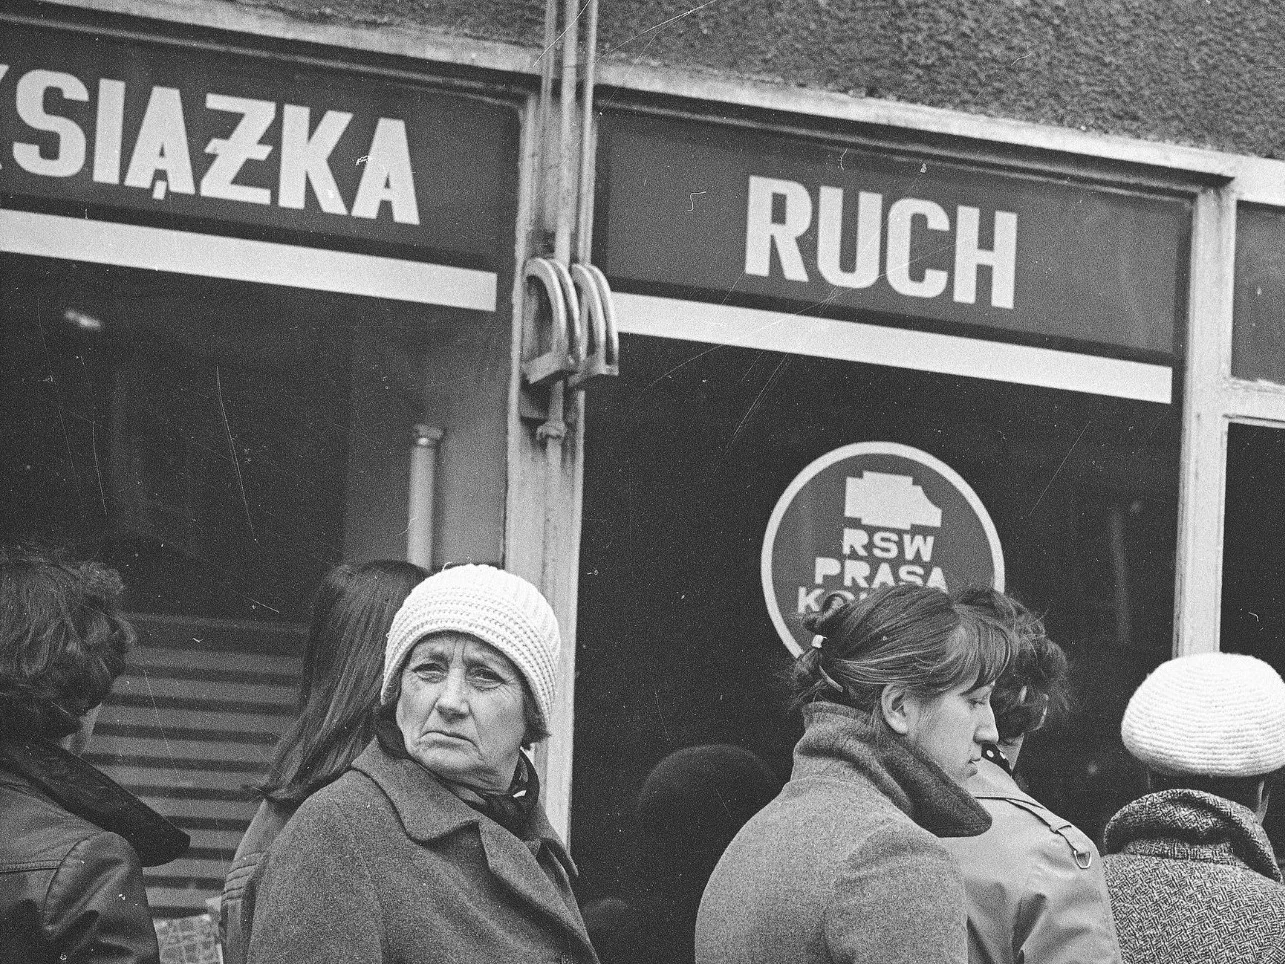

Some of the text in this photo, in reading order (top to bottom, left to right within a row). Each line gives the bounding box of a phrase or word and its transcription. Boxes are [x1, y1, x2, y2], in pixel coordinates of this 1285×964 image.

[0, 64, 420, 225] SIĄŻKA
[745, 174, 1018, 310] RUCH
[815, 557, 948, 593] PRASA
[843, 528, 934, 562] RSW
